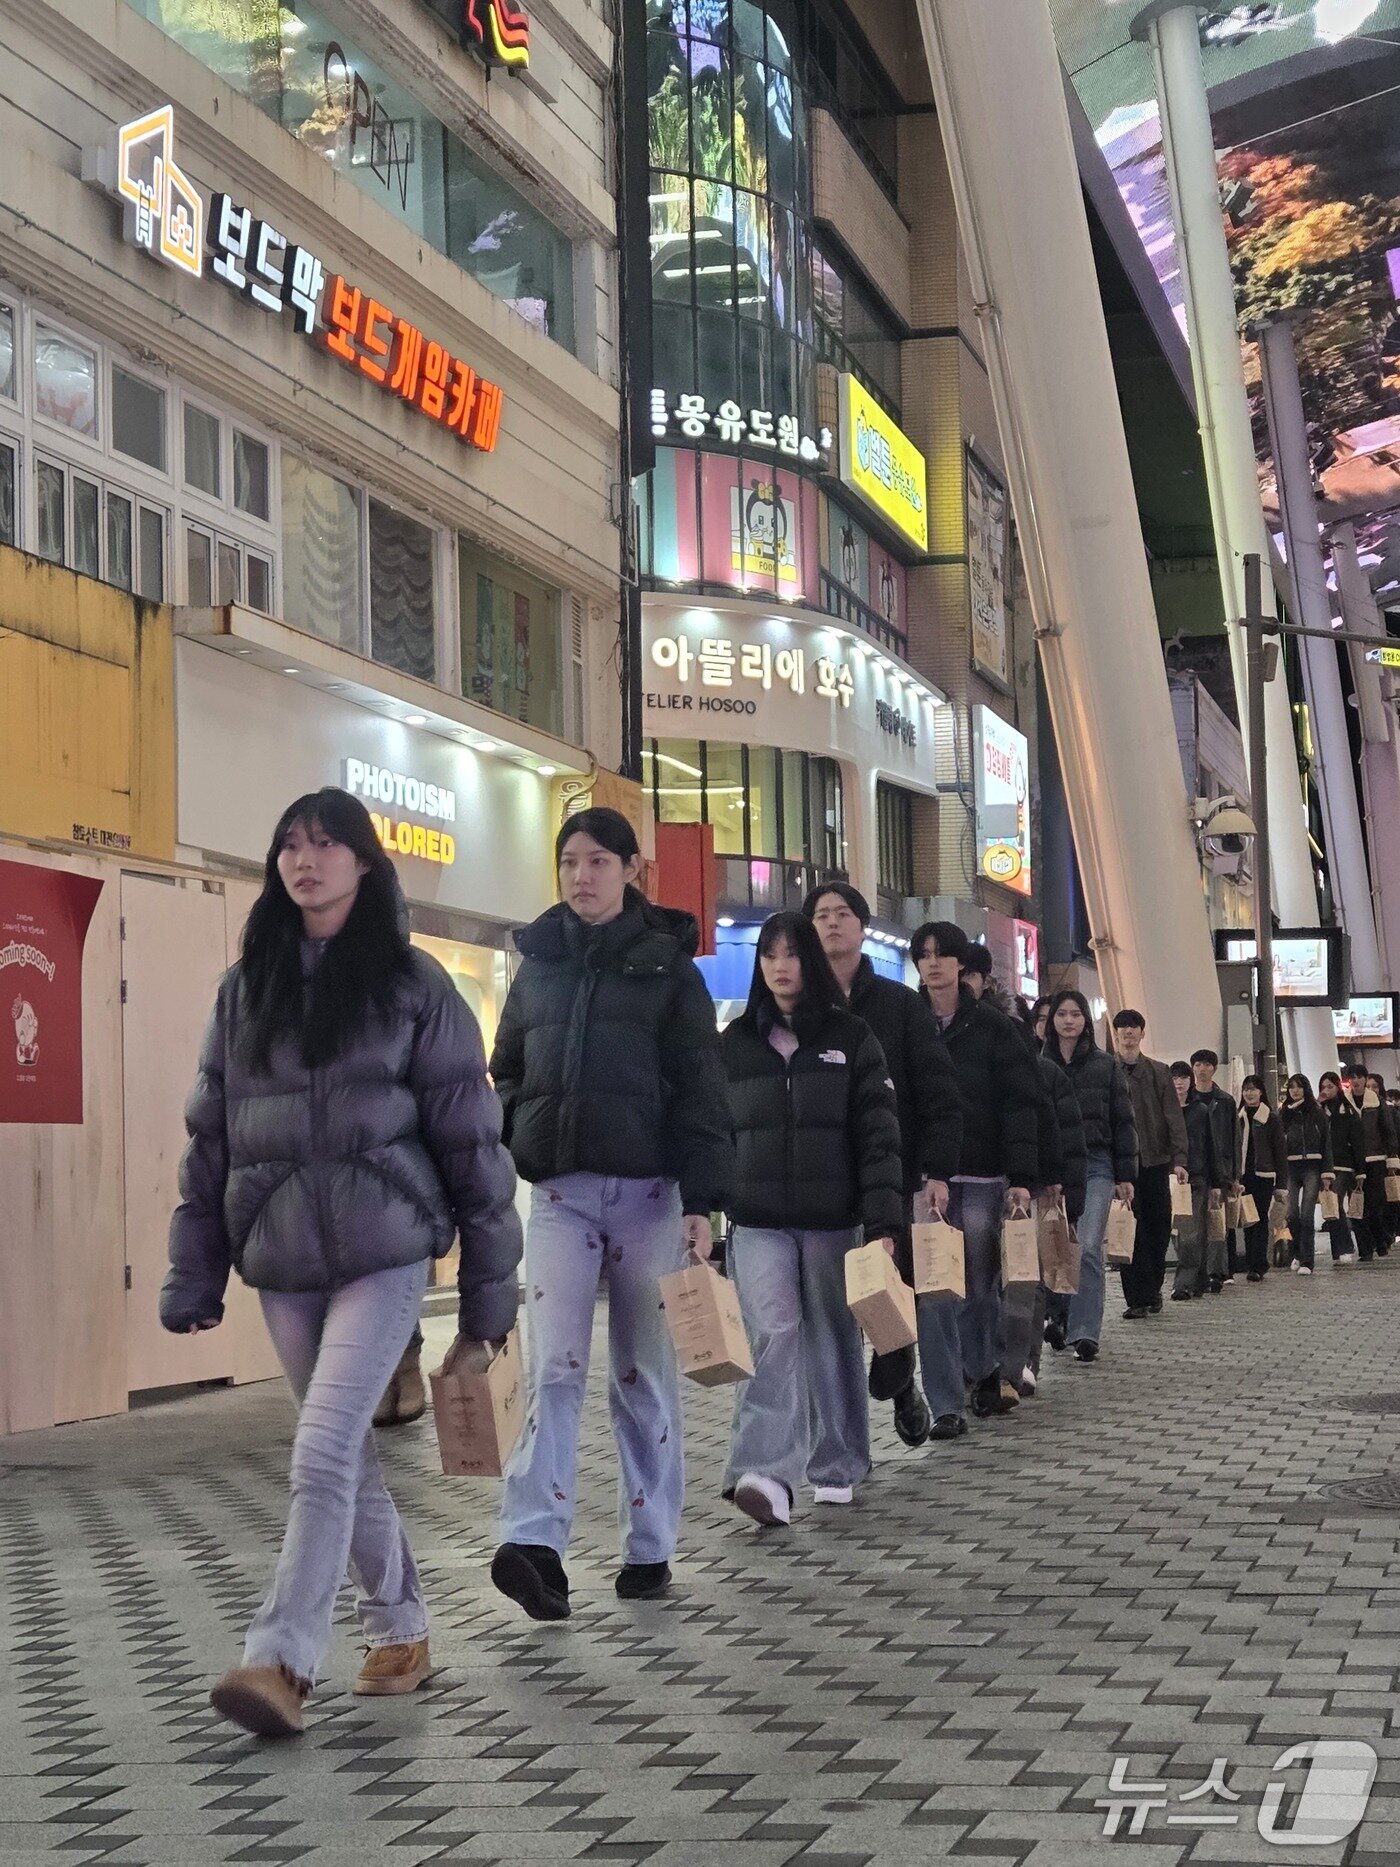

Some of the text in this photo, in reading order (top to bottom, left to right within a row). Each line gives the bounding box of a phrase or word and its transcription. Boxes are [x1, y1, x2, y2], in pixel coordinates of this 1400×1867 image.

[213, 193, 503, 453] 보드막 보드게임카페
[674, 393, 799, 456] 몽유도원
[651, 634, 855, 709] 아뜰리에 호수
[641, 692, 757, 715] ELIER HOSOO
[346, 757, 456, 821] PHOTOISM
[370, 812, 456, 865] OLORED
[0, 940, 26, 969] oming
